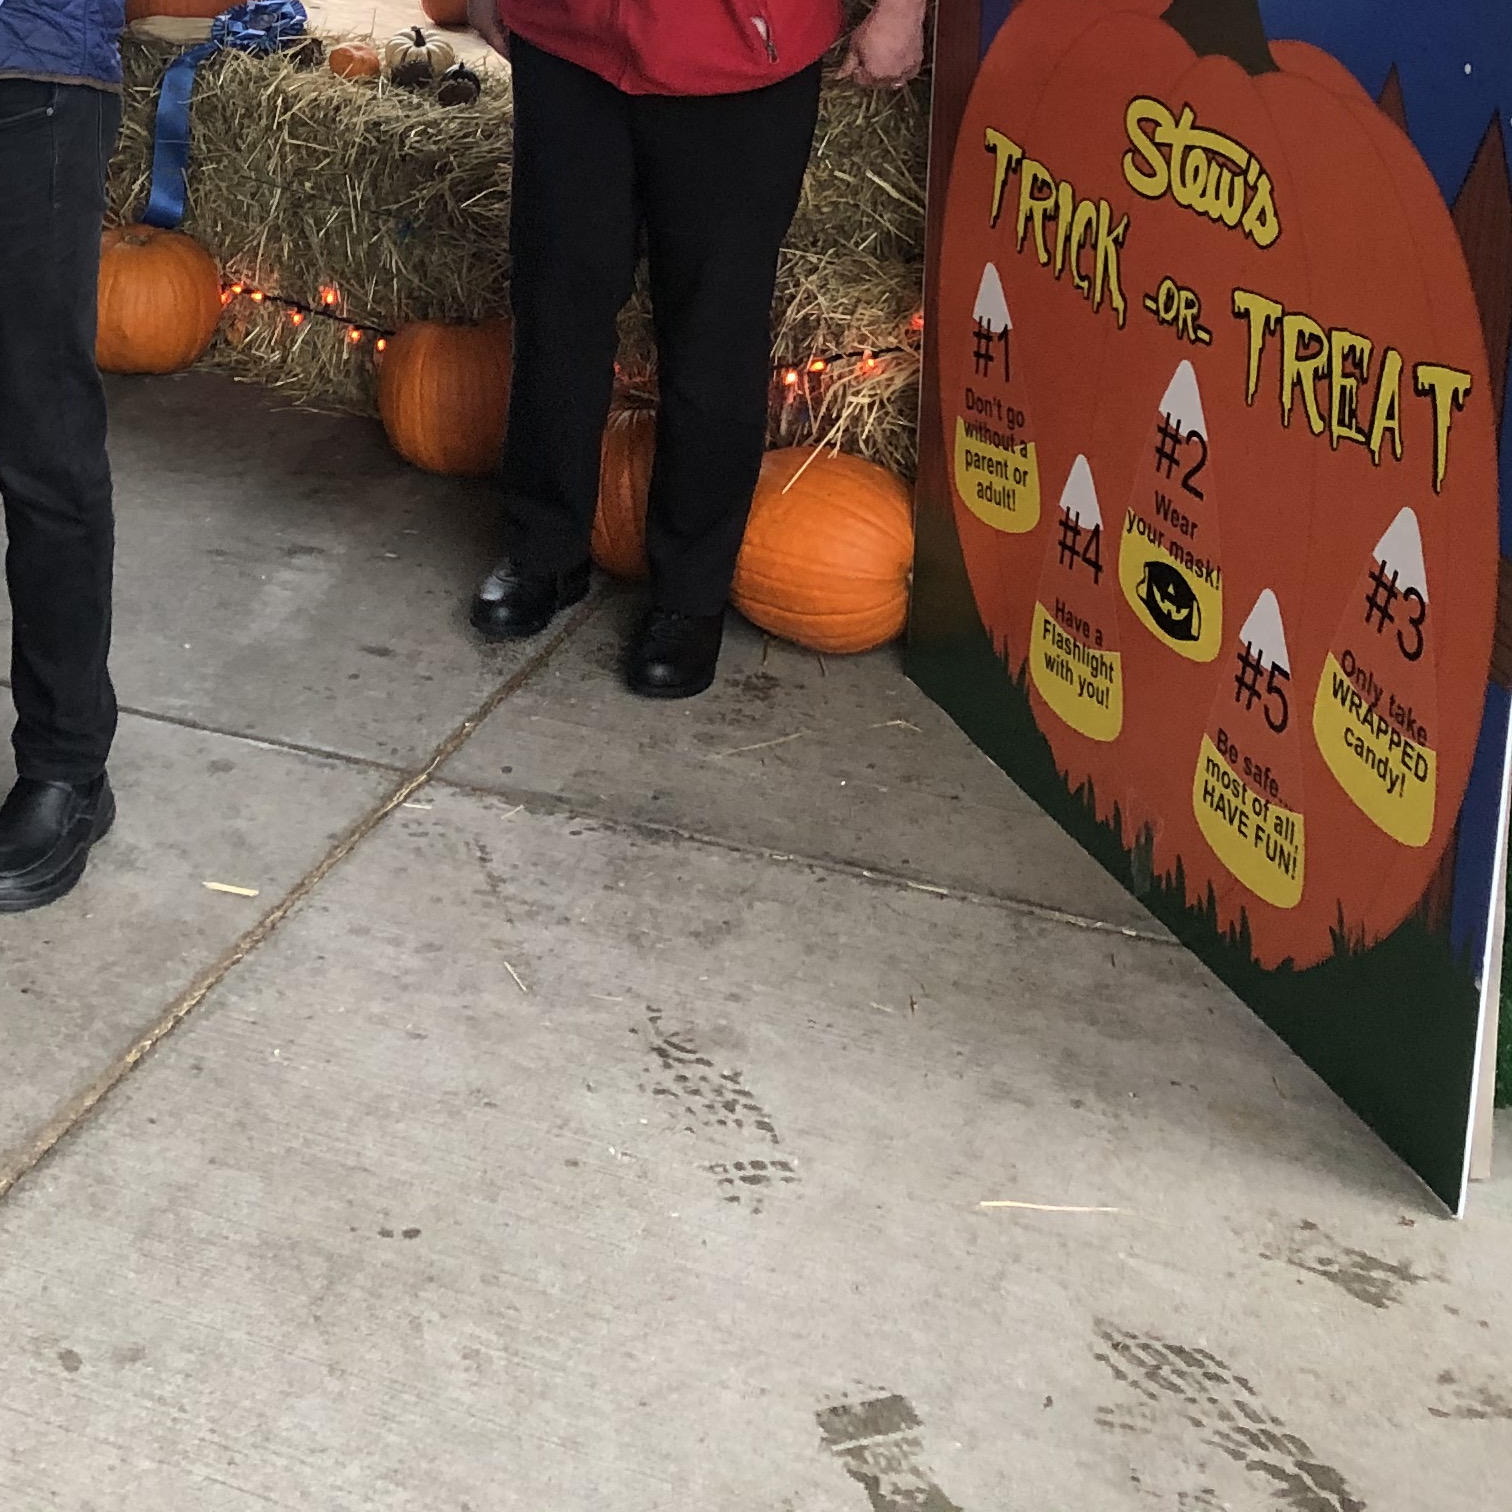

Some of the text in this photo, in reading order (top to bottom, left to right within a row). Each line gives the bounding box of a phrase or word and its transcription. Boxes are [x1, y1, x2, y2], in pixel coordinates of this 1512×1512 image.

[1123, 95, 1282, 248] Stew's
[985, 127, 1130, 329] TRICK
[1233, 287, 1473, 494] TREAT
[973, 315, 1013, 384] #1
[963, 420, 1028, 458] without a
[965, 387, 1025, 430] Don't go
[965, 449, 1028, 487] parent or
[1155, 412, 1208, 501] #2
[976, 481, 1016, 512] adult!
[1154, 490, 1199, 541] Wear
[1058, 506, 1104, 586] #4
[1126, 509, 1222, 591] your mask!
[1055, 596, 1103, 648] Have a
[1365, 559, 1426, 662] #3
[1042, 617, 1115, 684] Flashlight
[1044, 652, 1110, 709] with you!
[1235, 641, 1291, 734] #5
[1341, 649, 1428, 746] Only take
[1216, 728, 1238, 764] Be
[1332, 672, 1429, 783] WRAPPED
[1344, 726, 1407, 799] candy!
[1206, 755, 1247, 806] most
[1251, 796, 1270, 823] of
[1202, 779, 1298, 881] HAVE FUN!
